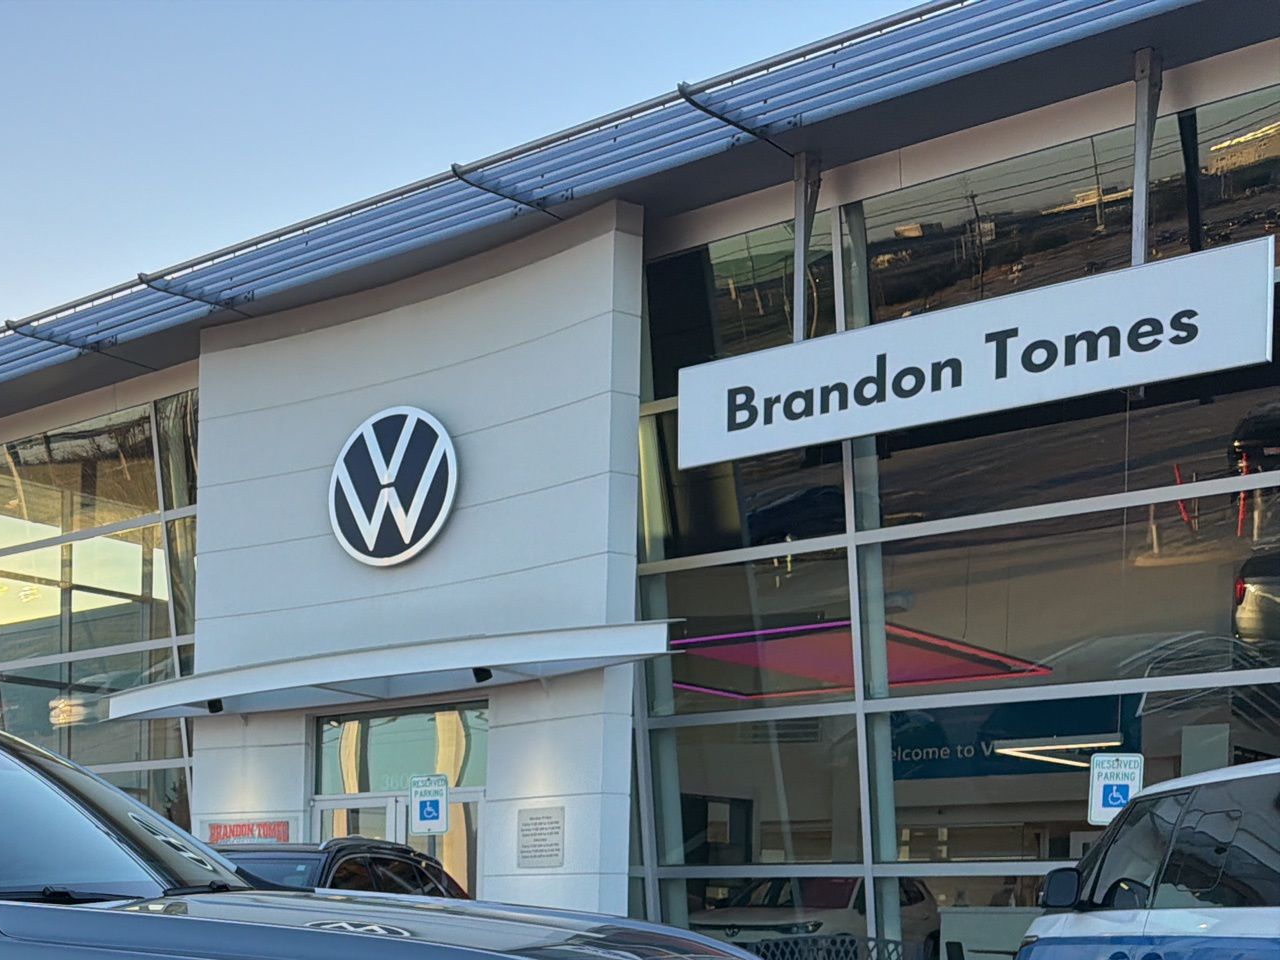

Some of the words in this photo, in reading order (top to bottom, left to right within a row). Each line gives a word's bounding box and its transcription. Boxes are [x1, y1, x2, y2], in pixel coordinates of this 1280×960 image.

[727, 353, 962, 432] Brandon
[985, 309, 1199, 379] Tomes
[329, 406, 458, 566] VW
[891, 745, 950, 761] elcome
[957, 744, 975, 758] to
[1095, 760, 1139, 769] RESERVED
[1097, 771, 1136, 781] PARKING
[412, 779, 446, 788] RESERVED
[414, 788, 444, 798] PARKING
